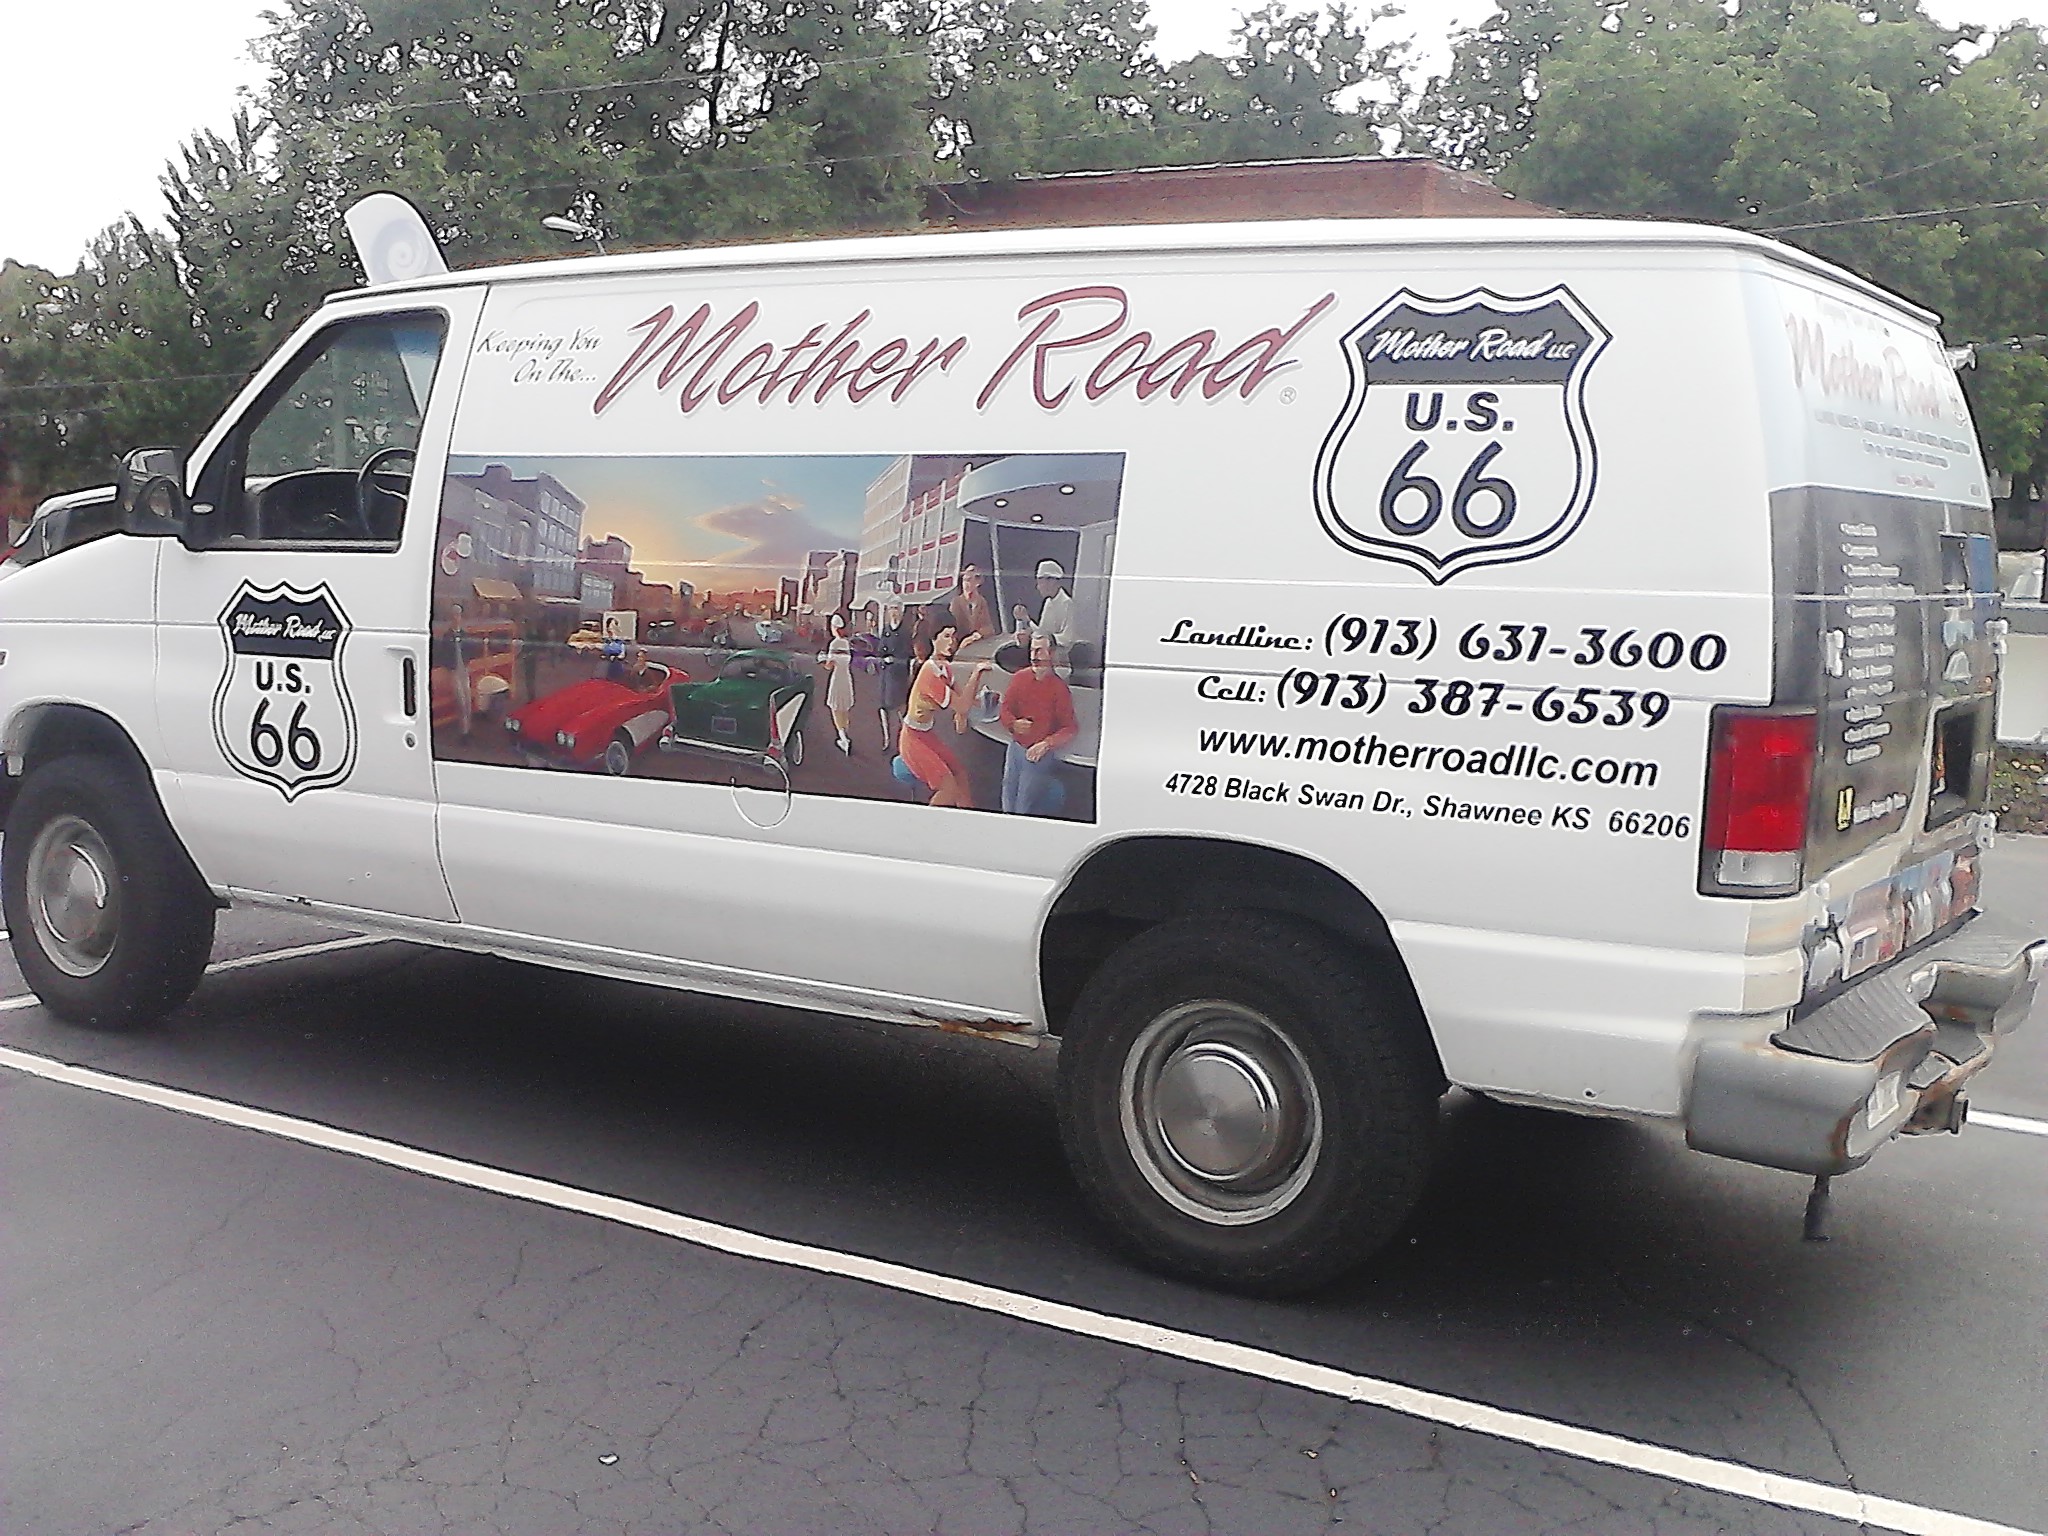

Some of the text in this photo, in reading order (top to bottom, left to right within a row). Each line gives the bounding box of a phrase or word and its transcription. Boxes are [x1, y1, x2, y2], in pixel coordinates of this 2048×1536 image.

[476, 325, 602, 361] Keeping You
[513, 358, 543, 383] On
[593, 284, 1336, 416] Mother Road
[1367, 327, 1578, 361] Mother Road LLC
[1404, 392, 1514, 433] U.S.
[1379, 438, 1519, 539] 66
[232, 613, 282, 636] Mother
[282, 615, 325, 638] Road
[1160, 612, 1729, 672] Landline: (913) 631-3600
[255, 661, 312, 694] U.S.
[1197, 666, 1671, 729] Cell: (913) 387-6539
[250, 696, 321, 772] 66
[1199, 727, 1659, 788] www.motherroadllc.com
[1165, 772, 1692, 840] 4728 Black Swan Dr., Shawnee KS 66206
